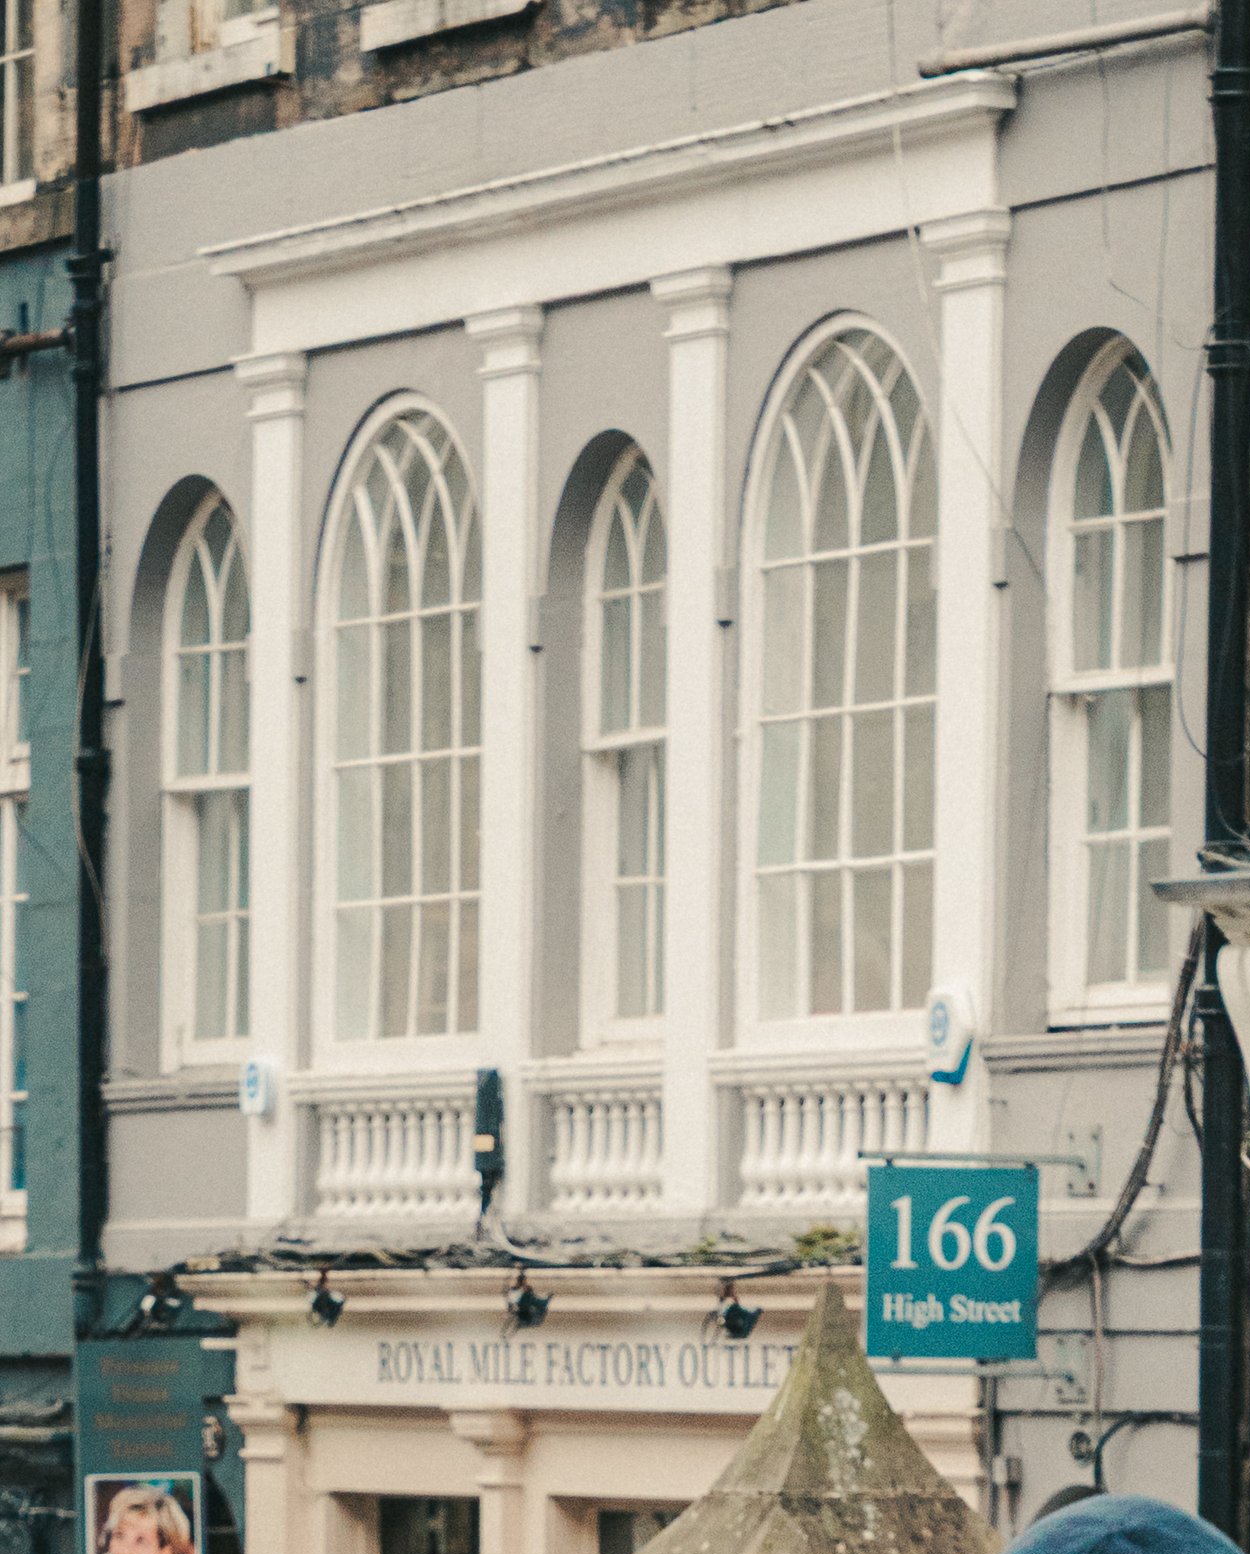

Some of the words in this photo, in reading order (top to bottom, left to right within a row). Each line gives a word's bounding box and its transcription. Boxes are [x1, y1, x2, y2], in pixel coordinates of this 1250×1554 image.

[889, 1195, 1017, 1272] 166
[882, 1292, 945, 1329] High
[949, 1293, 1022, 1323] Street
[377, 1341, 462, 1383] ROYAL
[468, 1342, 537, 1385] MILE
[545, 1342, 671, 1388] FACTORY
